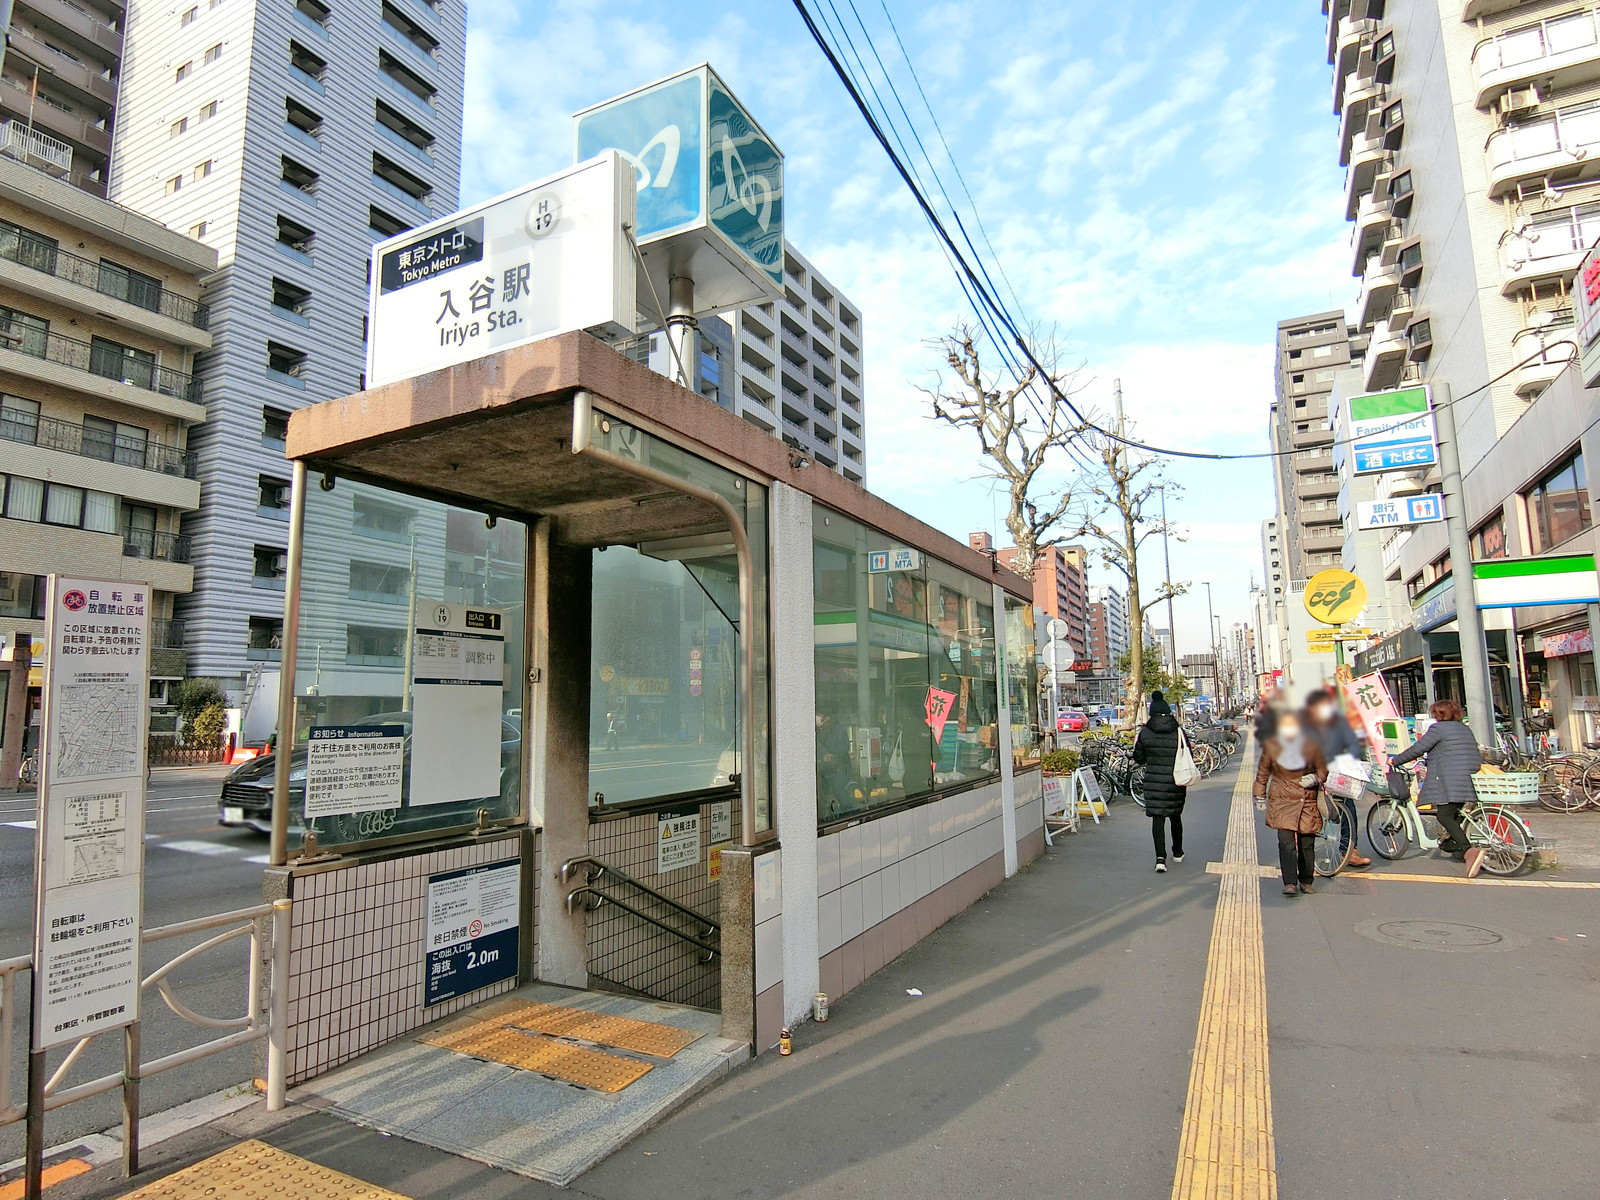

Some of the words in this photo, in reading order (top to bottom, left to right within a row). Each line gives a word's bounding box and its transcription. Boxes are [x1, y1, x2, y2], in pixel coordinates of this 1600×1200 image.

[538, 200, 548, 214] H
[536, 213, 553, 230] 19
[398, 231, 465, 270] 東京メトロ
[402, 263, 430, 283] Tokyo
[431, 254, 460, 272] Metro
[436, 262, 531, 325] 入谷駅
[440, 320, 480, 346] Iriya
[487, 309, 523, 332] Sta.
[1356, 418, 1427, 437] FamilyMart
[1364, 452, 1383, 468] 酒
[1389, 448, 1429, 464] たばこ
[1372, 502, 1395, 514] 銀行
[1370, 512, 1399, 525] ATM
[89, 589, 144, 603] 自転車
[87, 603, 145, 617] 放置禁止区域
[438, 615, 447, 623] 19
[468, 613, 485, 622] 出入口
[490, 615, 495, 628] 1
[63, 624, 142, 635] この区域に放置された
[62, 634, 142, 646] 自転車は、予告の有無に
[465, 650, 495, 664] 調整中
[1355, 683, 1383, 711] 花
[313, 729, 345, 739] お知らせ
[311, 742, 401, 753] 北千住方面をご利用のお客様
[673, 819, 697, 833] 強風注意
[712, 831, 721, 840] Left
[710, 850, 721, 861] 足元
[710, 866, 721, 877] 足元
[51, 913, 86, 929] 自転車は
[50, 916, 134, 943] 駐輪場をご利用下さい
[434, 926, 468, 945] 終日禁煙
[491, 918, 509, 927] Smoking
[432, 942, 472, 961] この出入口は
[431, 960, 451, 975] 海抜
[467, 949, 499, 970] 2.0m
